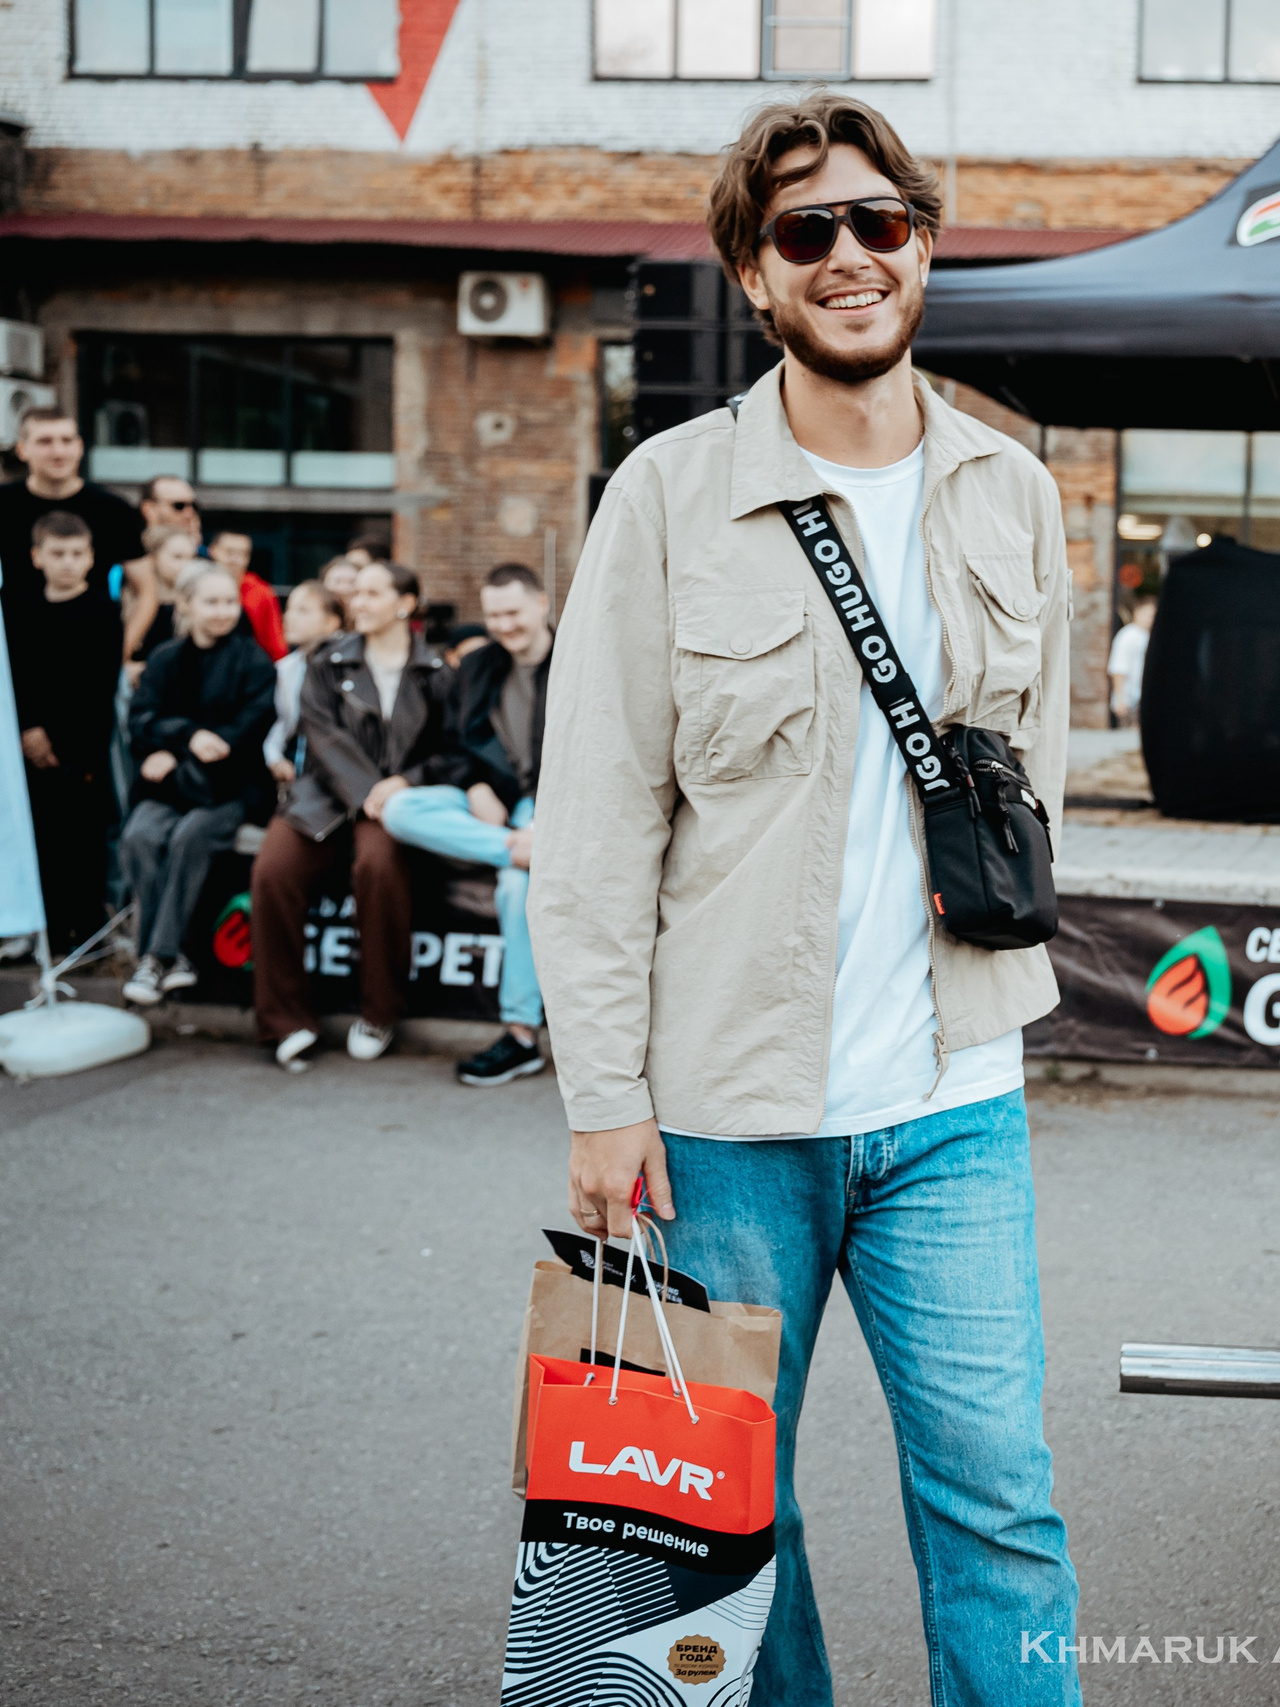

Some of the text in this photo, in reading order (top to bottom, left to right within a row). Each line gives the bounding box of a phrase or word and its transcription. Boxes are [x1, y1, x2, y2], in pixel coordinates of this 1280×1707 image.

[814, 539, 876, 632] HUGO
[861, 635, 920, 729] HGO
[409, 931, 506, 988] PET
[563, 1512, 709, 1557] Твое решение
[674, 1668, 687, 1676] За
[676, 1644, 718, 1654] БРЕНД
